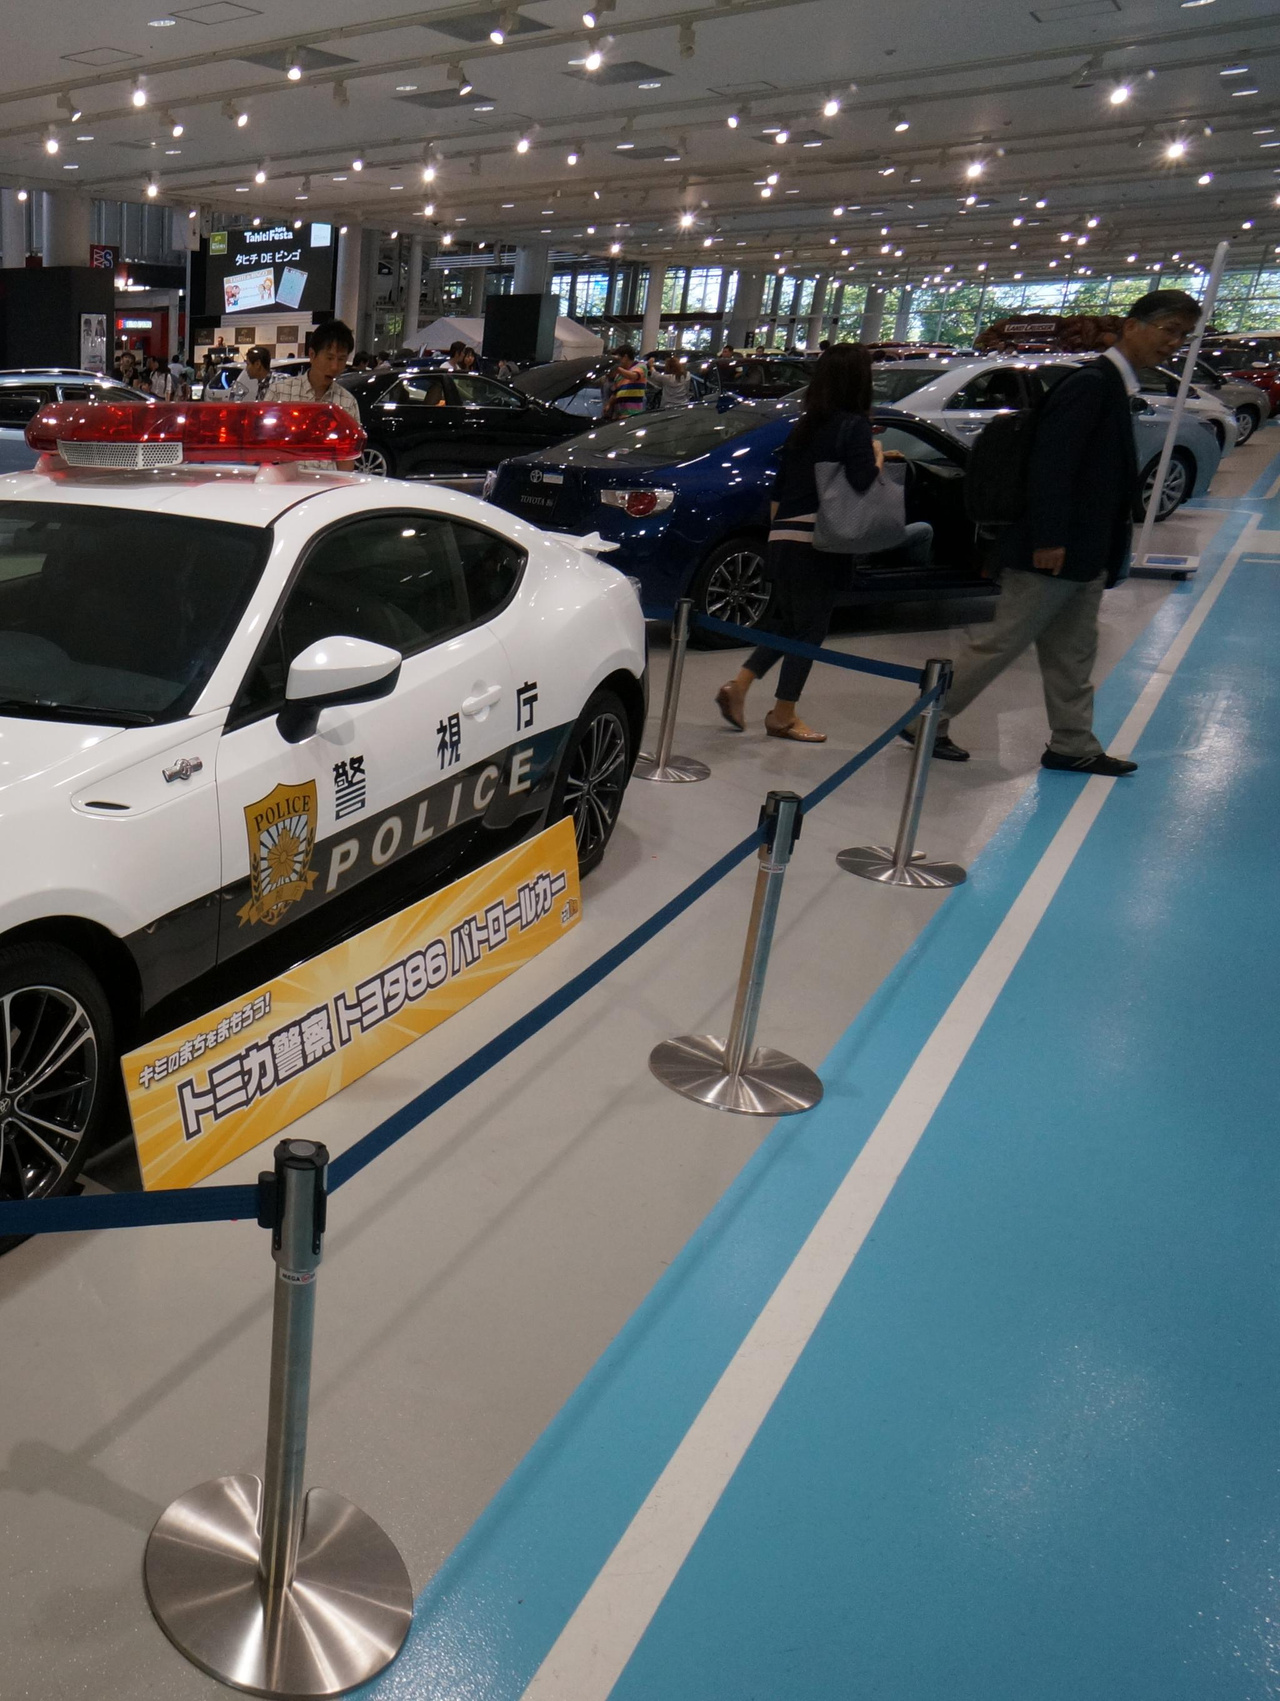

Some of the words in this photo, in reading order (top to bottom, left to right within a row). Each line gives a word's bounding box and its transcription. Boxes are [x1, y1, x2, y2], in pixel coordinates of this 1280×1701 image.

[260, 252, 273, 263] DE
[332, 681, 539, 821] 警視庁
[253, 795, 311, 833] POLICE
[325, 748, 534, 894] POLICE
[177, 1002, 336, 1141] トミカ警察
[333, 938, 449, 1047] トヨタ86
[450, 869, 567, 977] パトロールカー
[282, 1272, 301, 1282] MEGA
